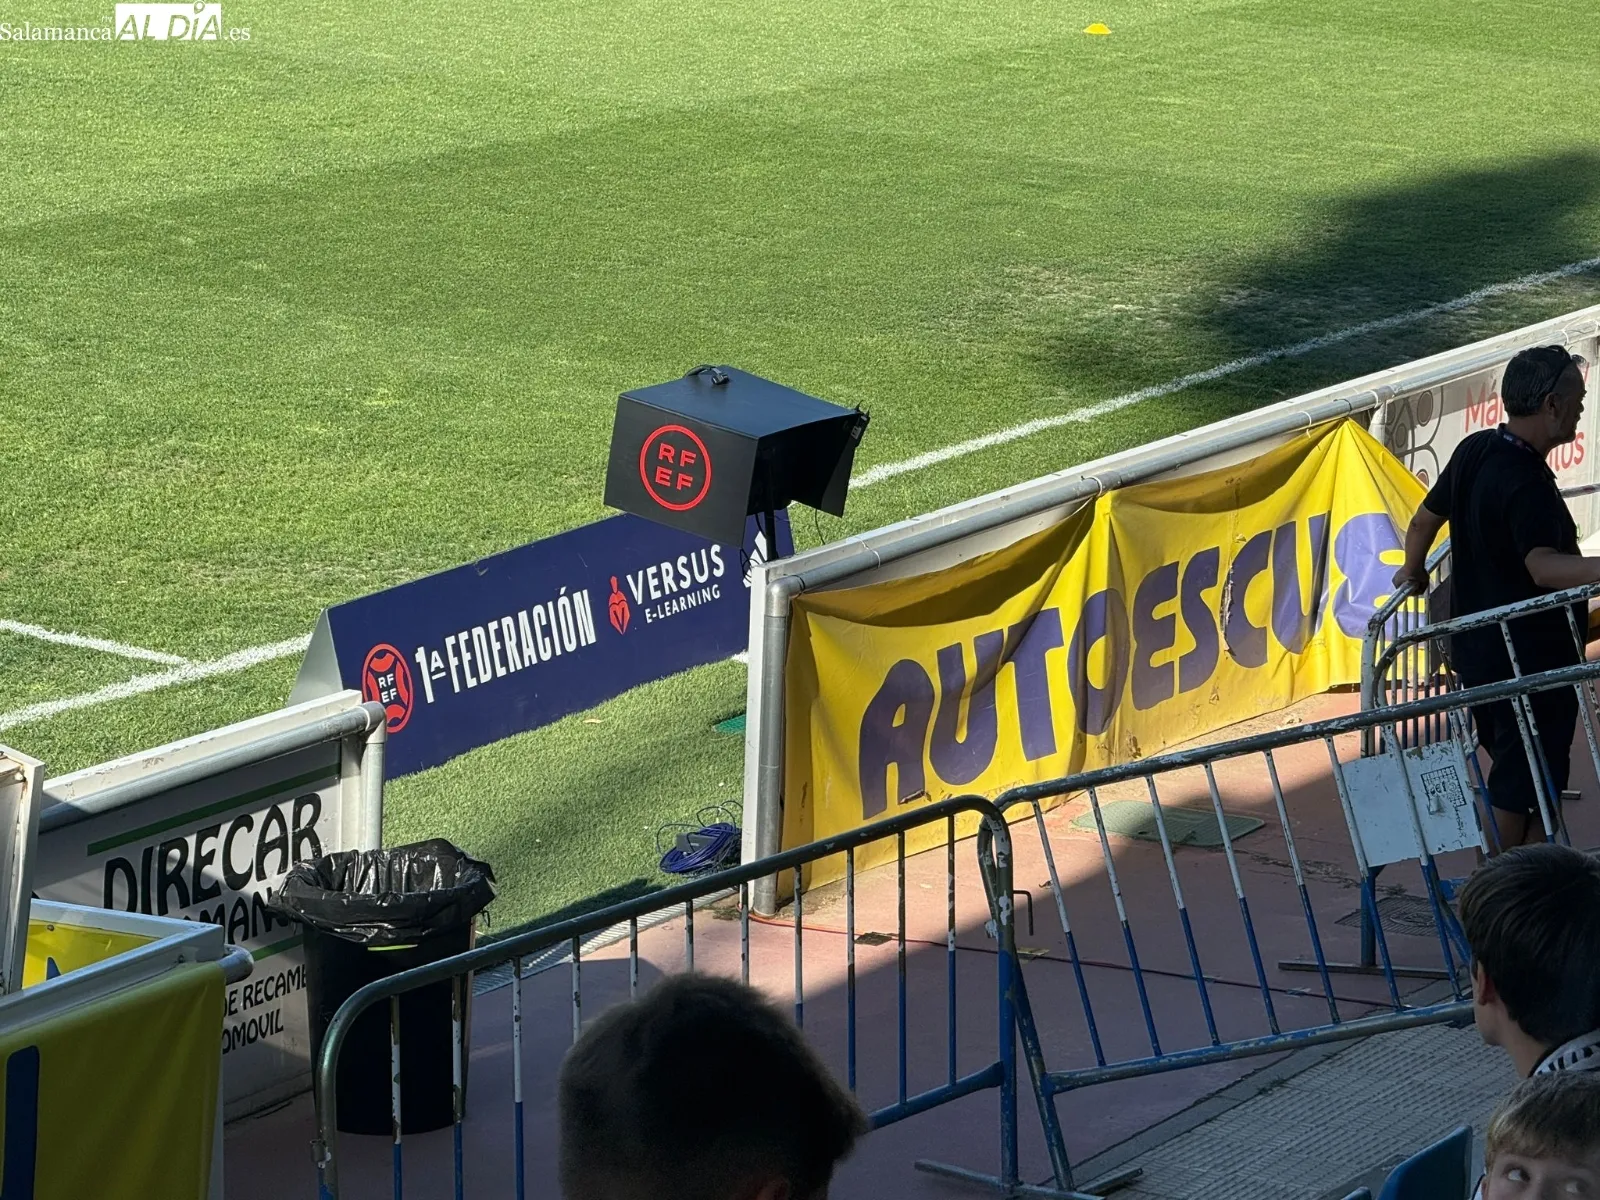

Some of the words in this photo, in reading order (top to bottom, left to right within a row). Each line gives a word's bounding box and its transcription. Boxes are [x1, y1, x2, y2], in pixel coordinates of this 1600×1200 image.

[658, 443, 697, 467] RF
[655, 465, 694, 490] EF
[626, 544, 725, 605] VERSUS
[644, 584, 721, 624] E-LEARNING
[445, 586, 597, 694] FEDERACIÓN
[378, 673, 395, 689] RF
[381, 688, 398, 703] EF
[103, 793, 323, 916] DIRECAR
